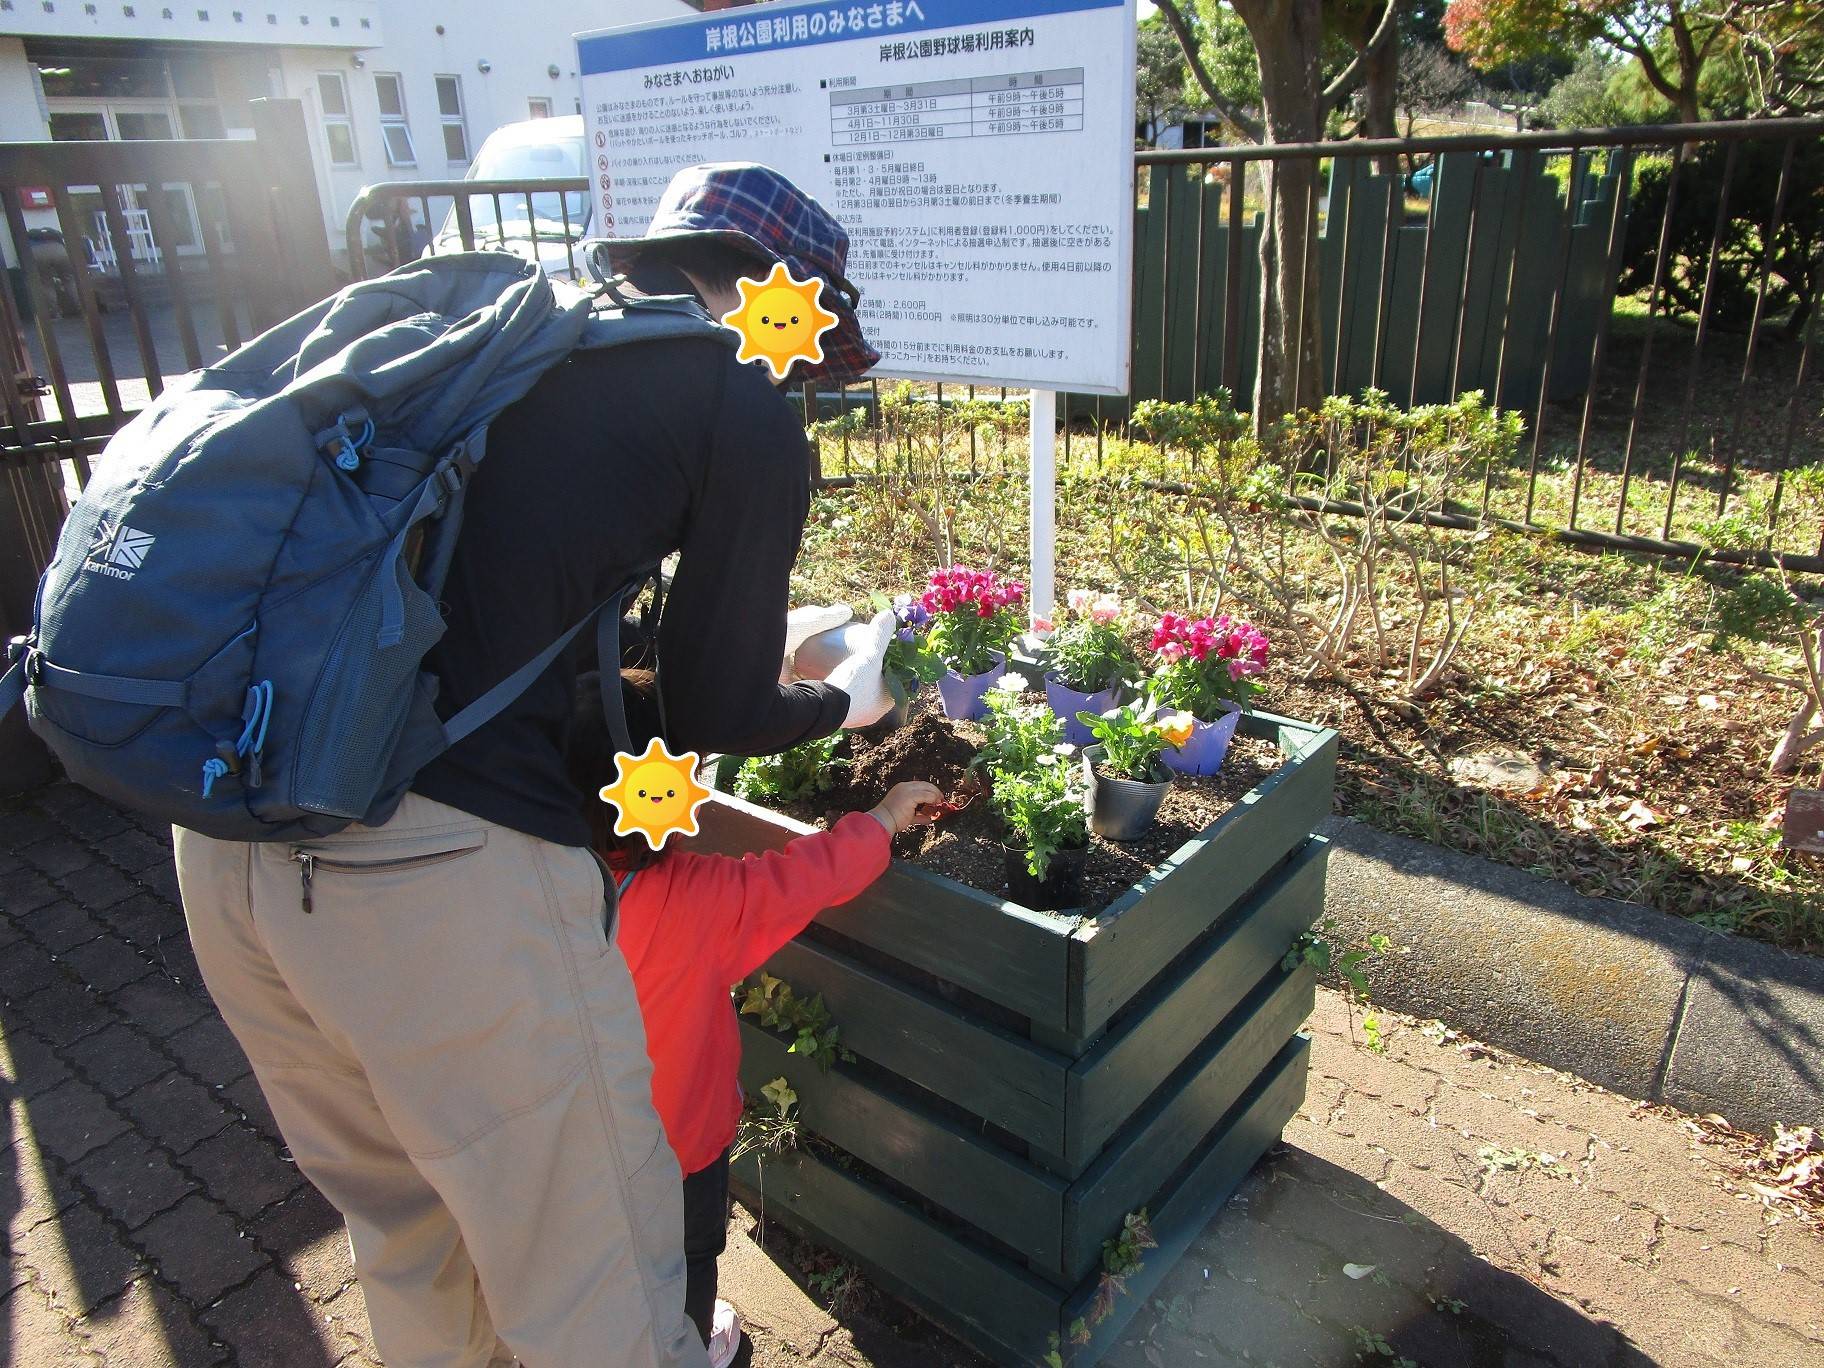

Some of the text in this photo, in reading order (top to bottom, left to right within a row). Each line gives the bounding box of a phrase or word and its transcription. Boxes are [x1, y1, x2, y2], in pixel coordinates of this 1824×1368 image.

[706, 1, 924, 51] 岸根公園利用のみなさまへ
[879, 27, 1034, 62] 岸根公園野球場利用案内
[643, 65, 735, 89] みなさまへおねがい
[829, 77, 857, 88] 利用期間
[848, 237, 1112, 248] はすべて電話、インターネットによる抽選申込制です。抽選後に空きがある
[868, 340, 1069, 360] 約時間の15分前までに利用料金のお支払をお願いします。
